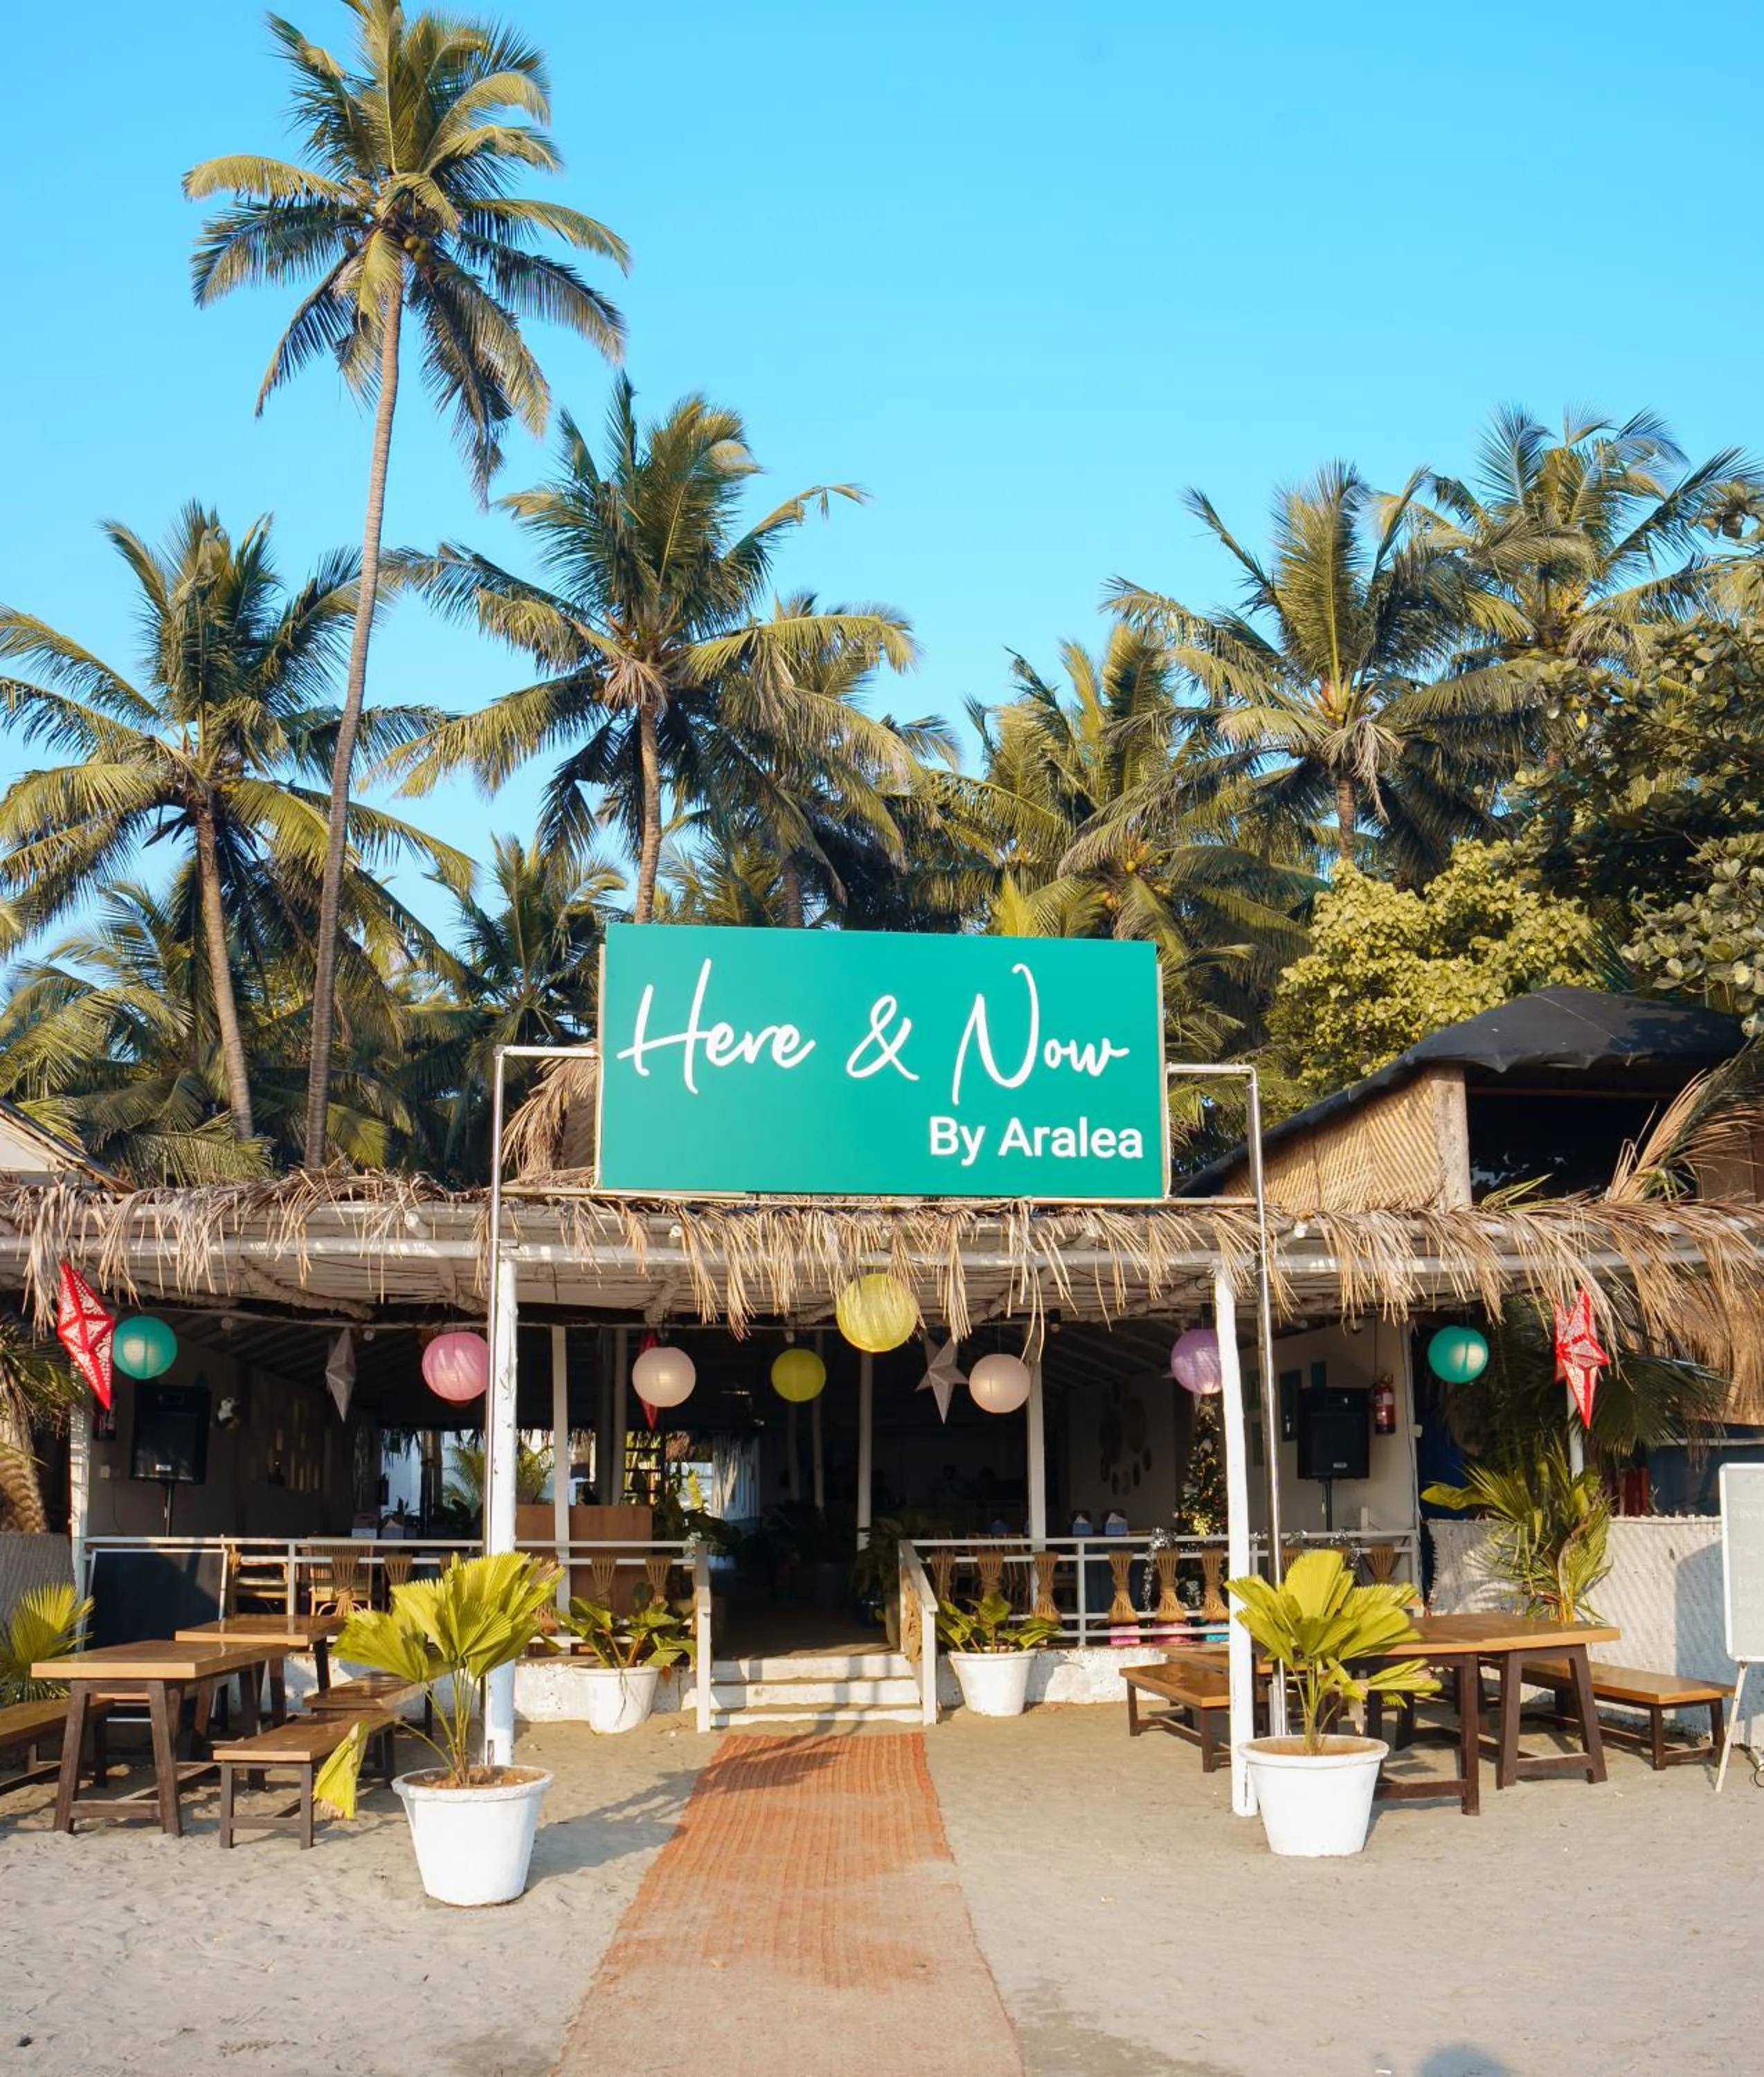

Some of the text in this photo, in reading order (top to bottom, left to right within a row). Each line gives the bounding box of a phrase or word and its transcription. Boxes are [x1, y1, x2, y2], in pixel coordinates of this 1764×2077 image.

[617, 958, 1130, 1105] Here & Now
[930, 1116, 1144, 1166] By Aralea
